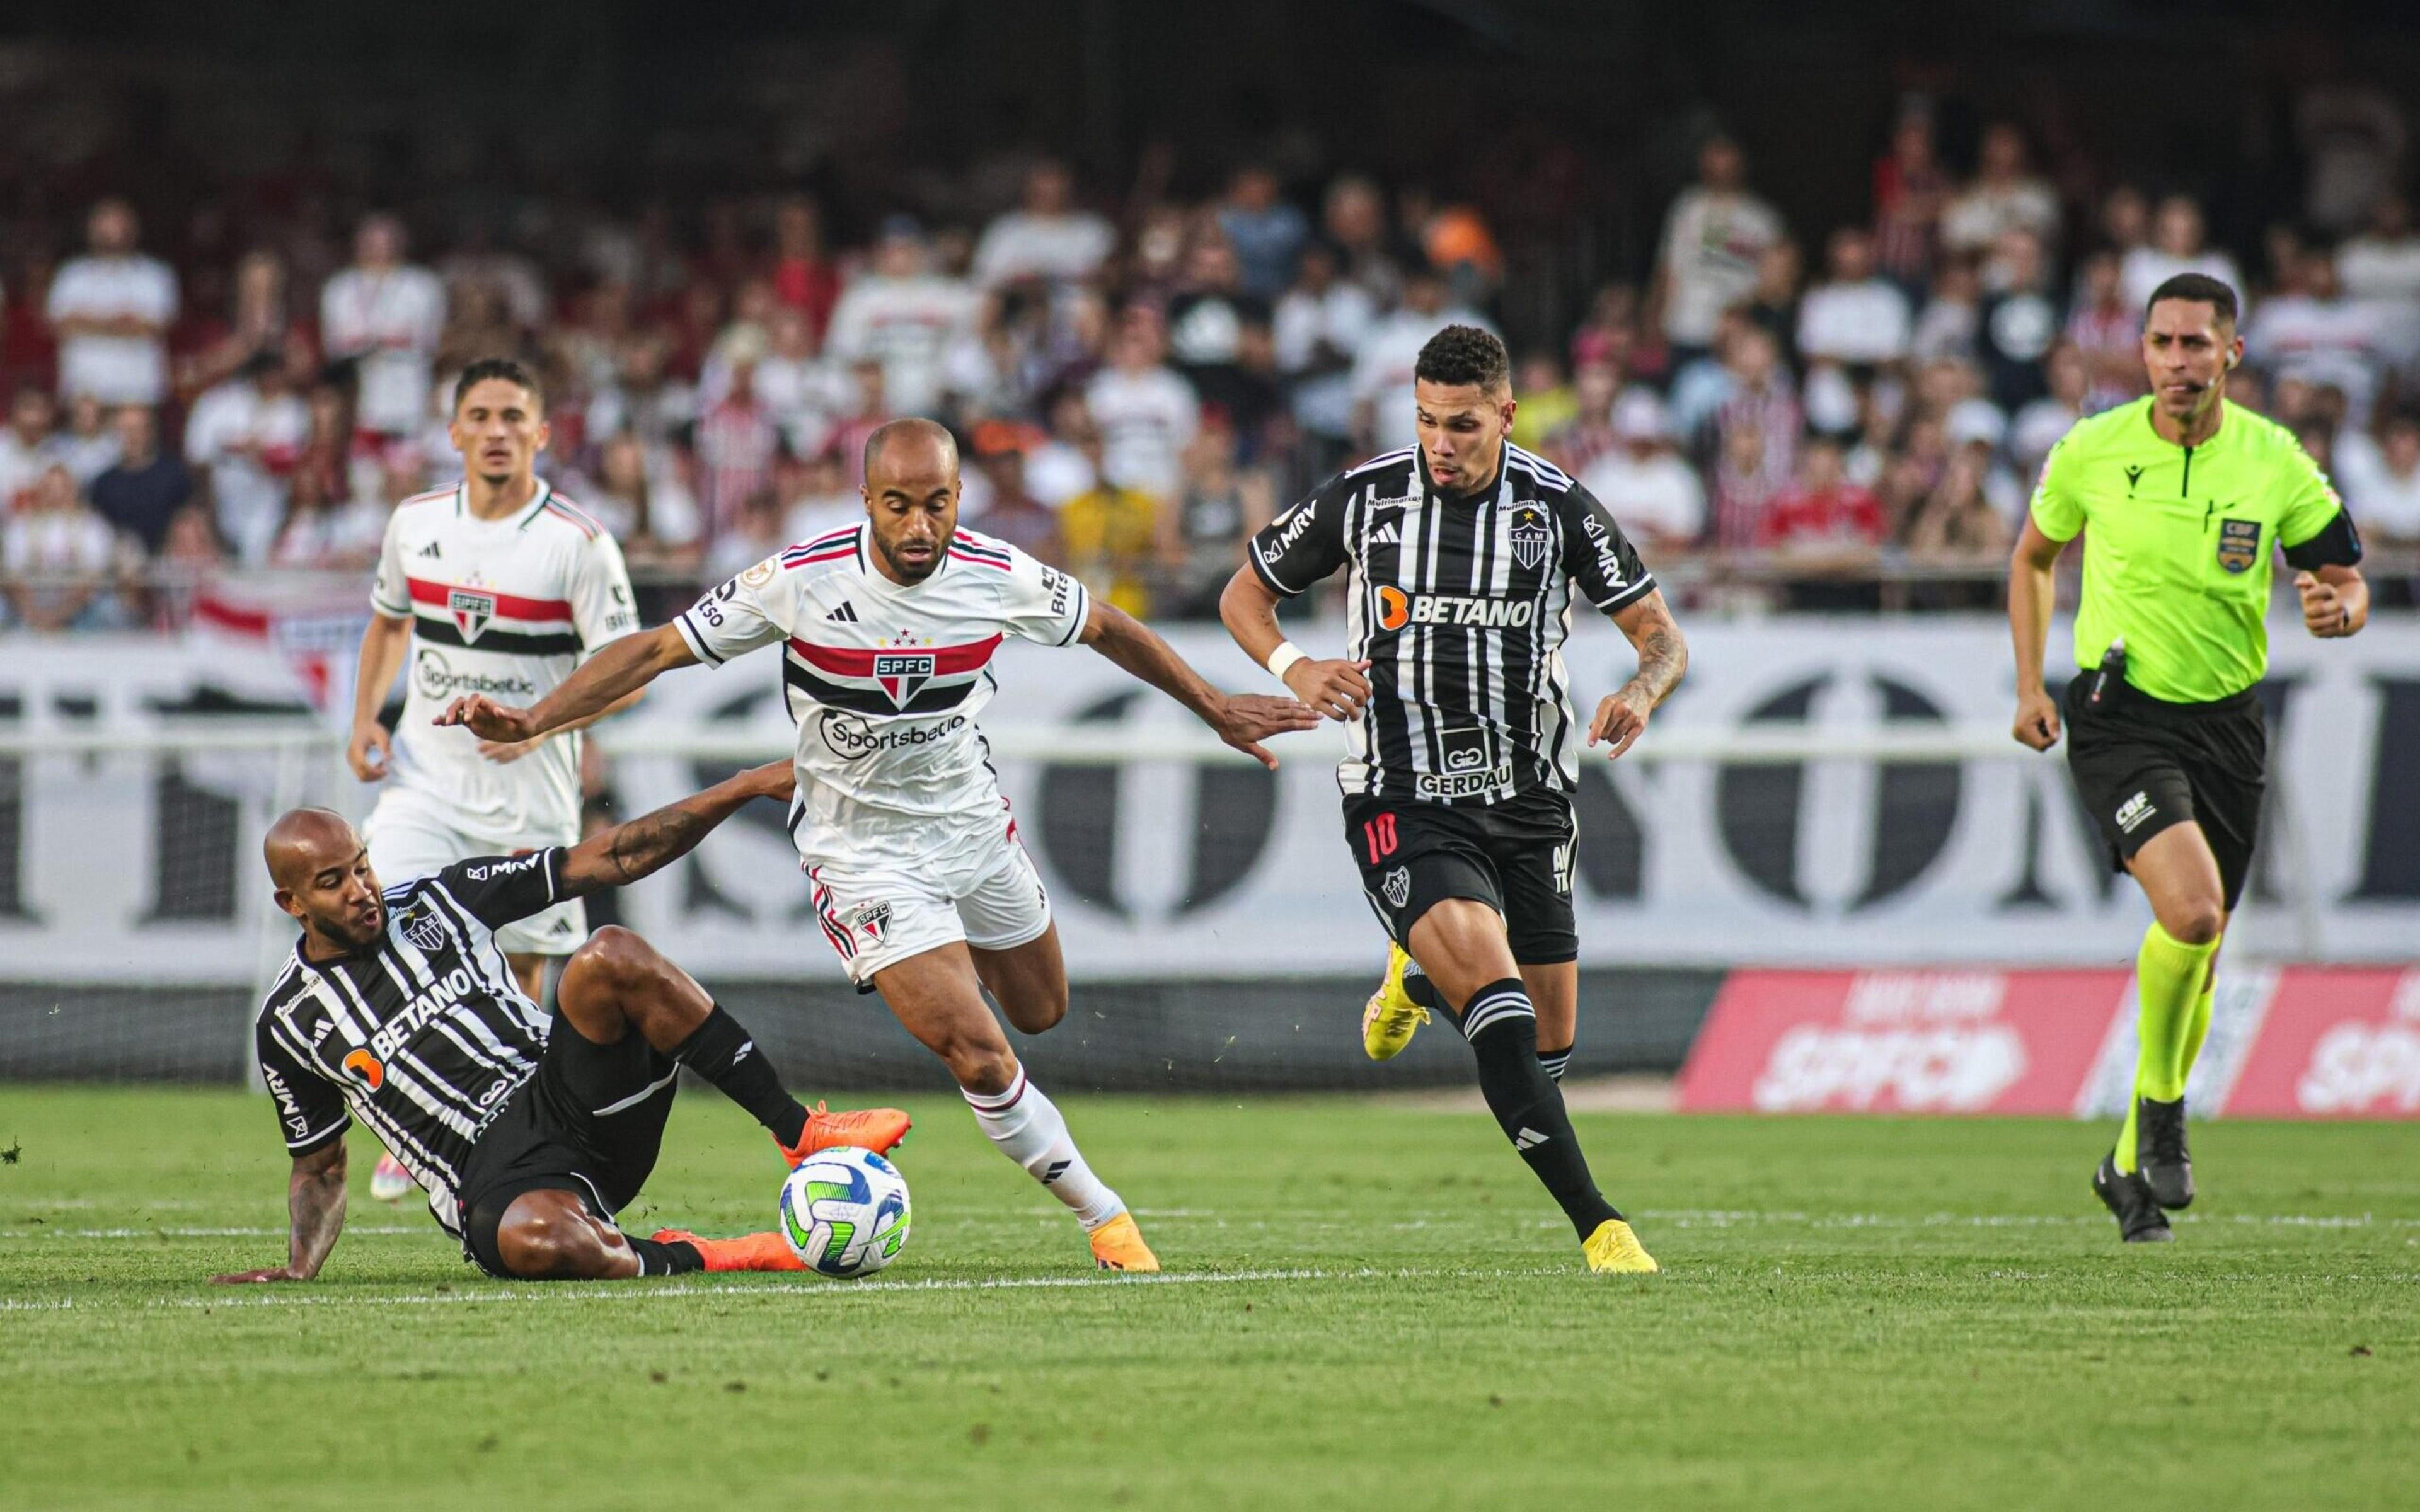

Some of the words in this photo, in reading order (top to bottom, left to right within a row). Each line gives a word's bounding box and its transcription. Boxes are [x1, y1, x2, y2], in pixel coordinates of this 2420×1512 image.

[1367, 496, 1422, 507] Multimarcas
[1280, 499, 1317, 550] MRV
[1593, 535, 1628, 587] MRV
[1051, 573, 1068, 616] Bits
[1411, 595, 1532, 627] BETANO
[879, 659, 930, 673] SPFC
[1420, 765, 1511, 795] GERDAU
[2116, 790, 2148, 826] CBF
[1364, 813, 1397, 864] 10
[492, 853, 541, 877] MRV
[410, 917, 435, 937] CAM
[860, 905, 887, 924] SPFC
[370, 968, 471, 1063] BETANO
[262, 1063, 300, 1115] MRV
